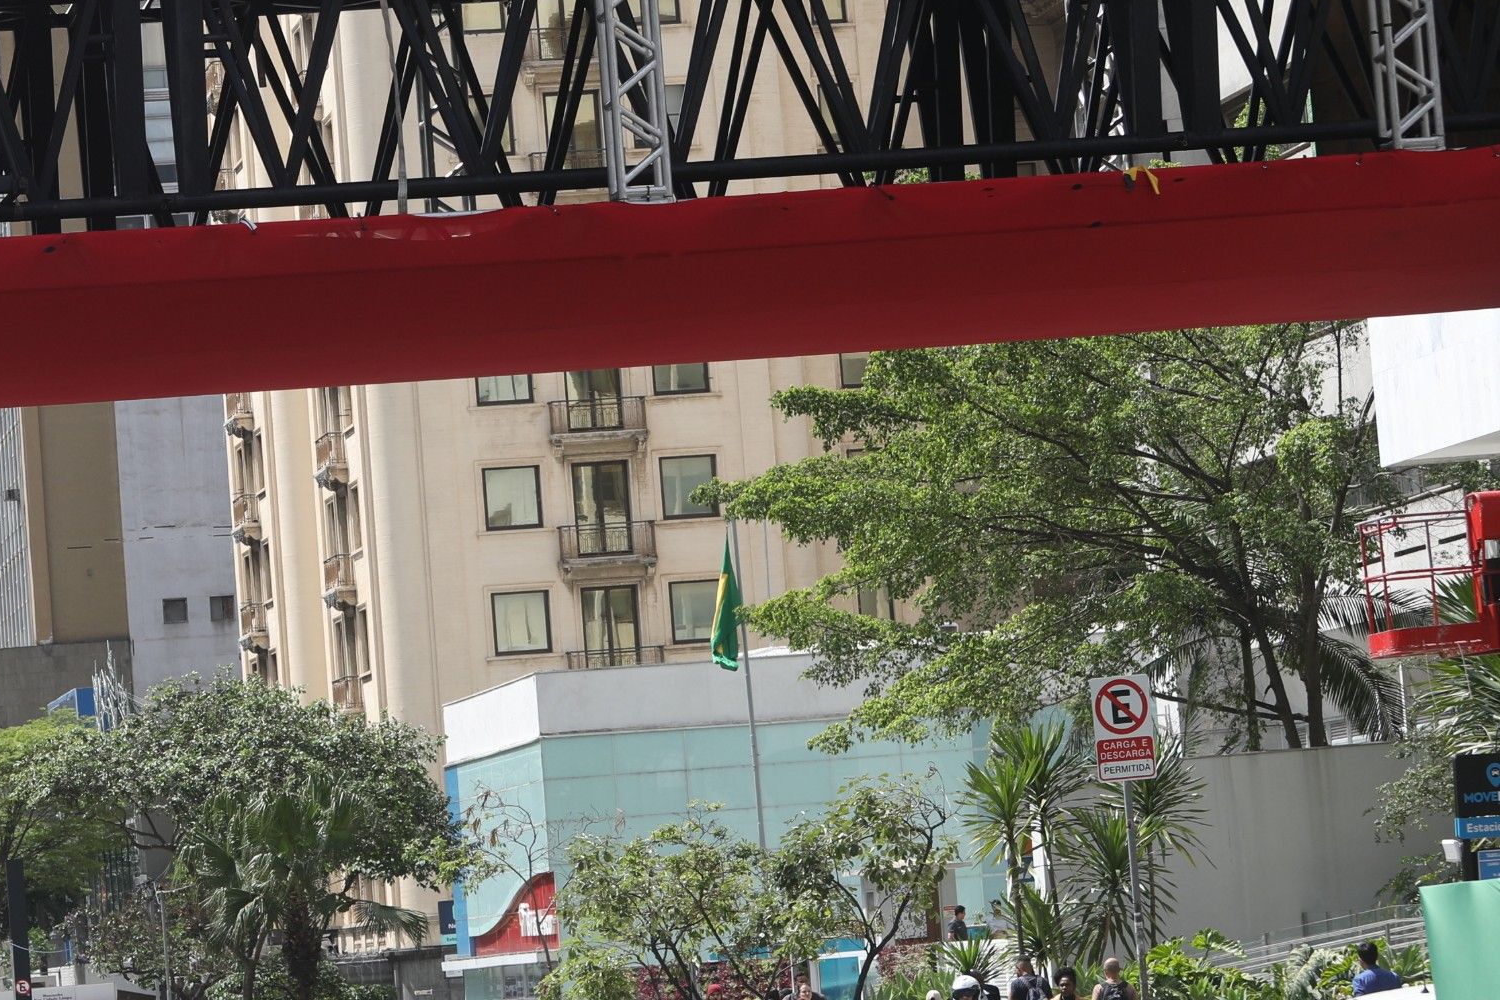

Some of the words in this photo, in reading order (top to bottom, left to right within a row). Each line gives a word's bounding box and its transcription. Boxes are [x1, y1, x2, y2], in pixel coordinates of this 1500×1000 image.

[1110, 689, 1133, 725] E
[1103, 740, 1137, 751] CARGA
[1141, 738, 1148, 747] E
[1100, 748, 1152, 760] DESCARGA
[1103, 763, 1151, 775] PERMITIDA
[1463, 791, 1500, 803] MOVE
